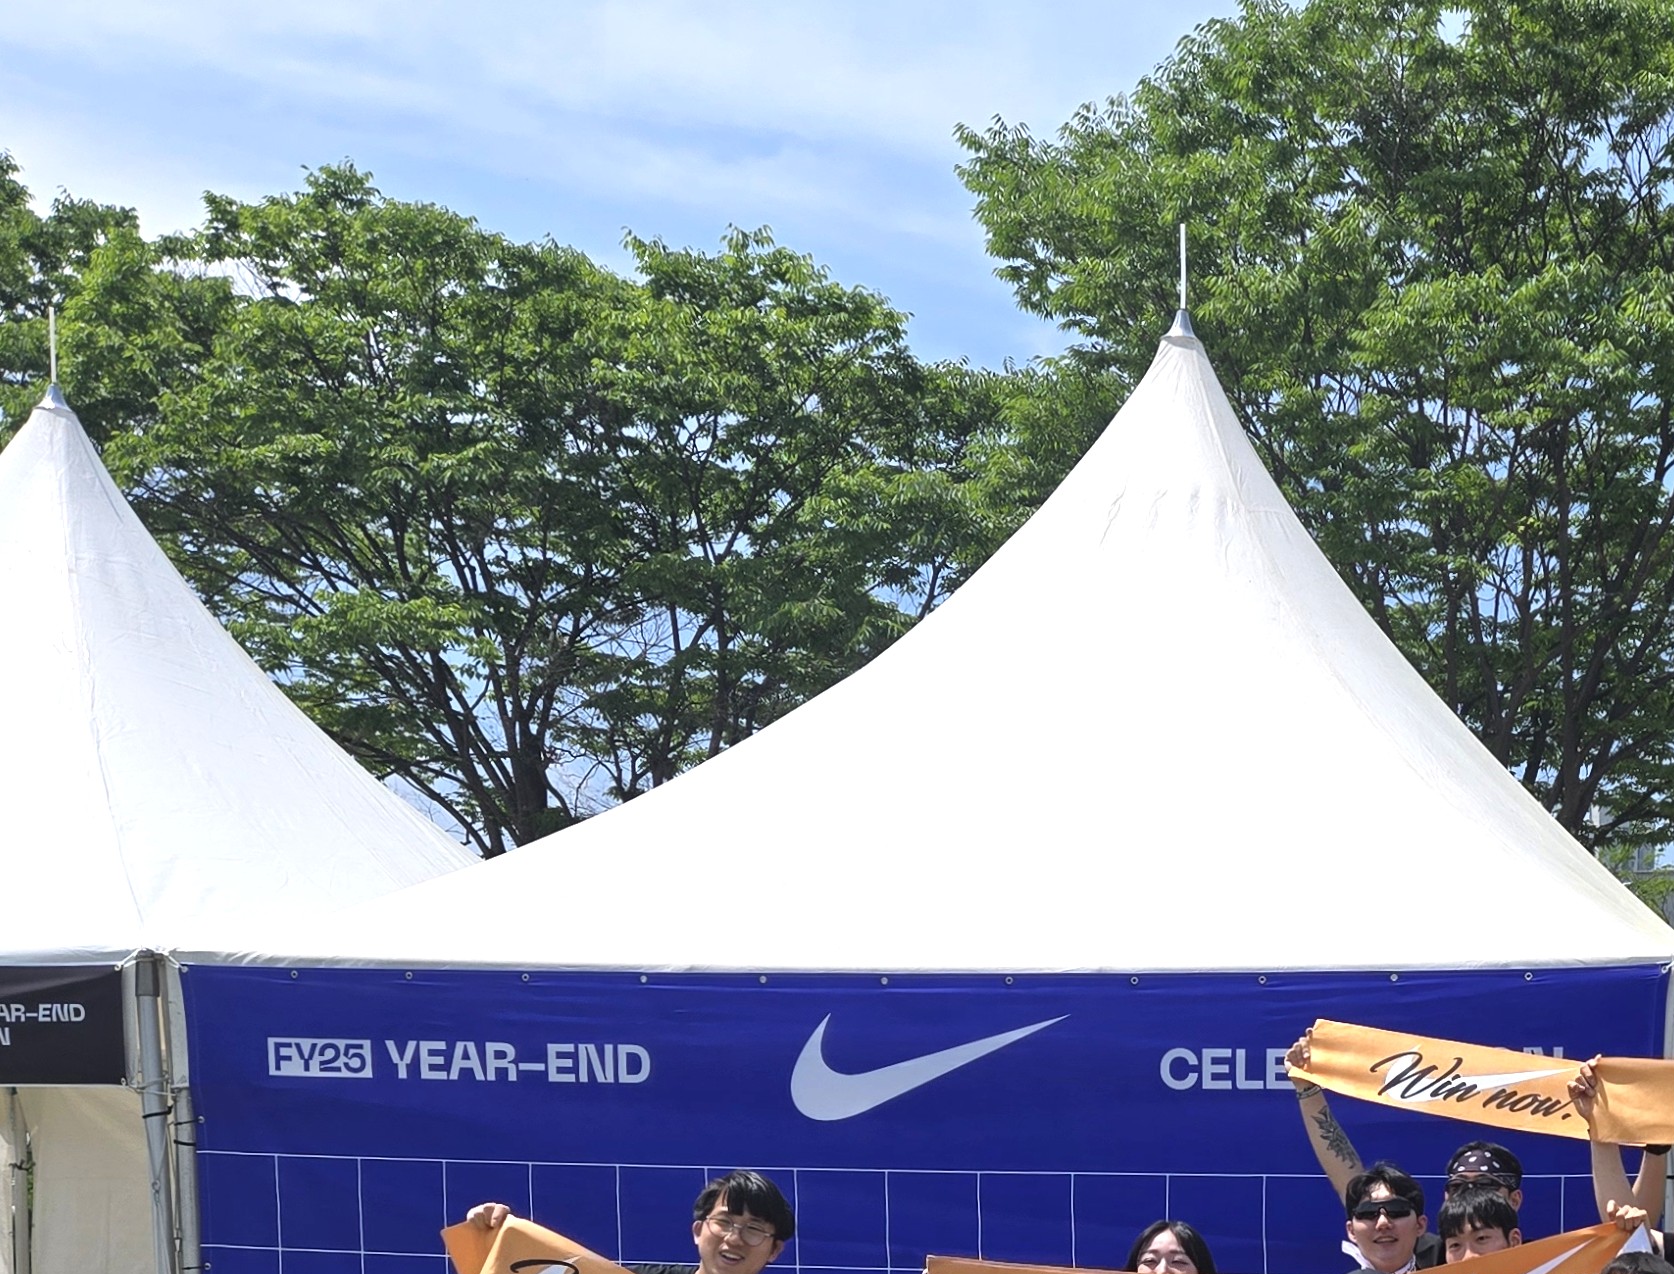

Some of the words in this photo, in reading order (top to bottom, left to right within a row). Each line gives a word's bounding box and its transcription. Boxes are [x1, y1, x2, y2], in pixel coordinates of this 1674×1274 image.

[273, 1041, 368, 1074] FY25
[385, 1040, 652, 1084] YEAR-END
[1370, 1052, 1483, 1103] Win
[1482, 1088, 1574, 1120] now.
